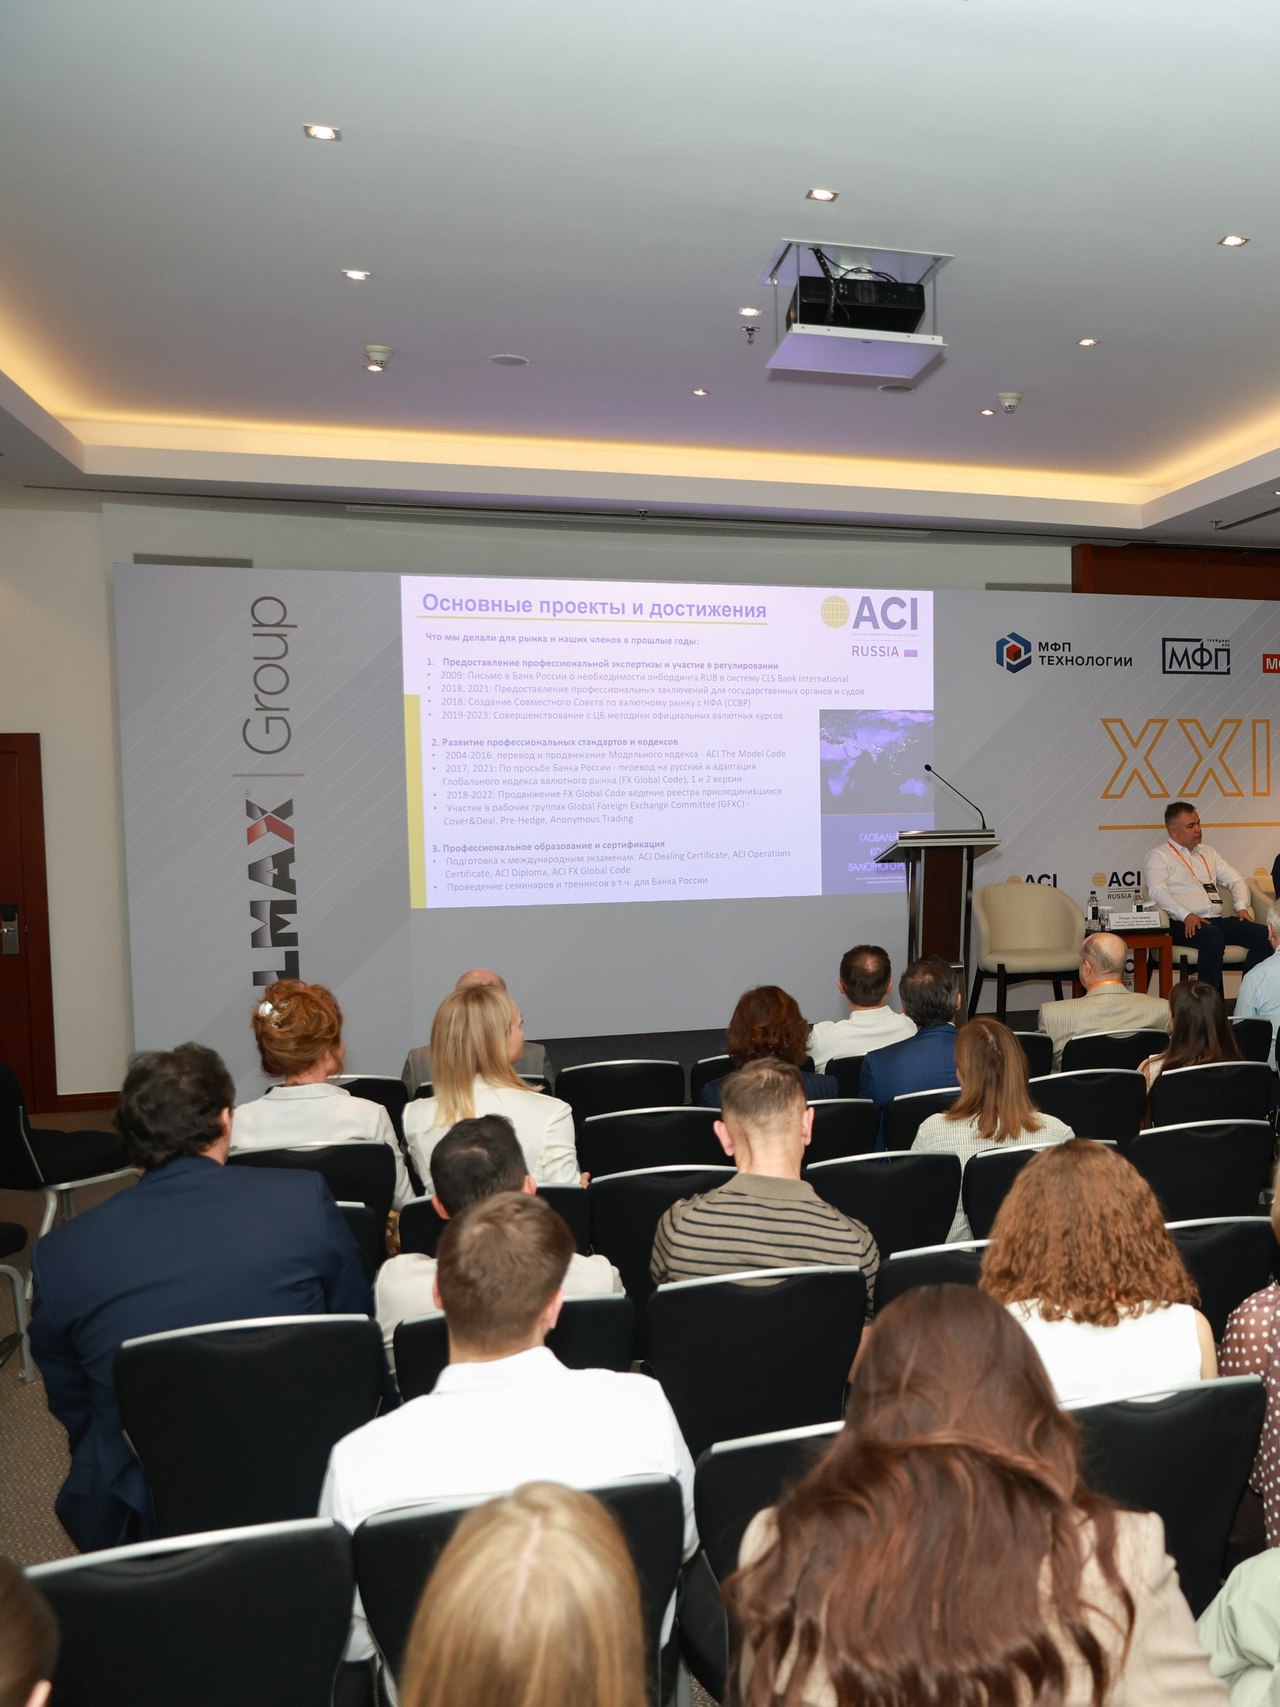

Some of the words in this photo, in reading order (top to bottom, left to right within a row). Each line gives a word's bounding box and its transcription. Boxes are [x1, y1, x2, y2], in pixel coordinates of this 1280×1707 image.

[422, 593, 532, 613] Основные
[539, 600, 625, 618] проекты
[632, 602, 643, 615] и
[649, 602, 766, 620] достижения
[852, 596, 918, 630] ACI
[425, 632, 442, 640] Что
[462, 634, 496, 643] делали
[498, 635, 516, 643] для
[518, 635, 547, 644] рынка
[631, 637, 672, 646] прошлые
[674, 638, 698, 646] годы:
[852, 645, 899, 657] RUSSIA
[1038, 642, 1071, 652] МФП
[1039, 656, 1133, 667] ТЕХНОЛОГИИ
[1168, 644, 1230, 670] МФП
[427, 657, 434, 665] 1.
[442, 657, 519, 668] Предоставление
[522, 658, 609, 669] профессиональной
[611, 661, 661, 669] экспертизы
[671, 662, 704, 670] участие
[714, 662, 778, 671] регулировании
[242, 596, 298, 755] Group
[440, 670, 464, 679] 2009:
[467, 671, 502, 679] Письмо
[512, 671, 533, 680] Банк
[536, 671, 566, 680] России
[577, 672, 645, 682] необходимости
[647, 673, 698, 683] онбординга
[700, 673, 717, 681] RUB
[726, 675, 759, 683] систему
[761, 674, 775, 682] CLS
[777, 674, 796, 682] Bank
[441, 684, 465, 693] 2018,
[467, 684, 492, 692] 2021:
[494, 684, 569, 694] Предоставление
[571, 685, 655, 695] профессиональных
[657, 685, 708, 694] заключений
[710, 687, 726, 695] для
[728, 687, 798, 696] государственных
[799, 688, 832, 696] органов
[841, 688, 866, 696] судов.
[441, 697, 465, 705] 2018:
[468, 697, 511, 706] Создание
[513, 697, 571, 706] Совместного
[573, 697, 603, 706] Совета
[618, 699, 666, 707] валютному
[703, 698, 722, 706] НФА
[724, 698, 751, 708] (ССВР)
[441, 710, 490, 719] 2019-2023:
[493, 710, 584, 720] Совершенствование
[593, 711, 605, 720] ЦБ
[607, 712, 649, 720] методики
[651, 711, 710, 720] официальных
[431, 738, 439, 746] 2.
[442, 738, 484, 746] Развитие
[486, 738, 575, 747] профессиональных
[577, 739, 627, 747] стандартов
[637, 739, 678, 747] кодексов
[445, 751, 494, 759] 2004-2016:
[497, 752, 535, 760] перевод
[545, 752, 606, 760] продвижение
[608, 750, 662, 759] Модельного
[664, 751, 698, 759] кодекса
[705, 749, 719, 757] ACI
[721, 749, 736, 757] The
[738, 749, 763, 757] Model
[765, 749, 785, 757] Code
[446, 803, 482, 812] Участие
[492, 802, 529, 812] рабочих
[531, 804, 565, 812] группах
[567, 802, 594, 810] Global
[597, 801, 627, 811] Foreign
[630, 801, 668, 810] Exchange
[670, 800, 715, 808] Committee
[717, 799, 744, 809] (GFXC)
[443, 816, 498, 826] Cover&Deal,
[500, 815, 547, 825] Pre-Hedge,
[549, 815, 600, 824] Anonymous
[602, 814, 633, 823] Trading
[860, 833, 898, 842] ГЛОБАЛЬ
[432, 844, 440, 852] 3.
[443, 842, 532, 854] Профессиональное
[534, 841, 592, 852] образование
[602, 839, 664, 850] сертификация
[1108, 871, 1141, 887] ACI
